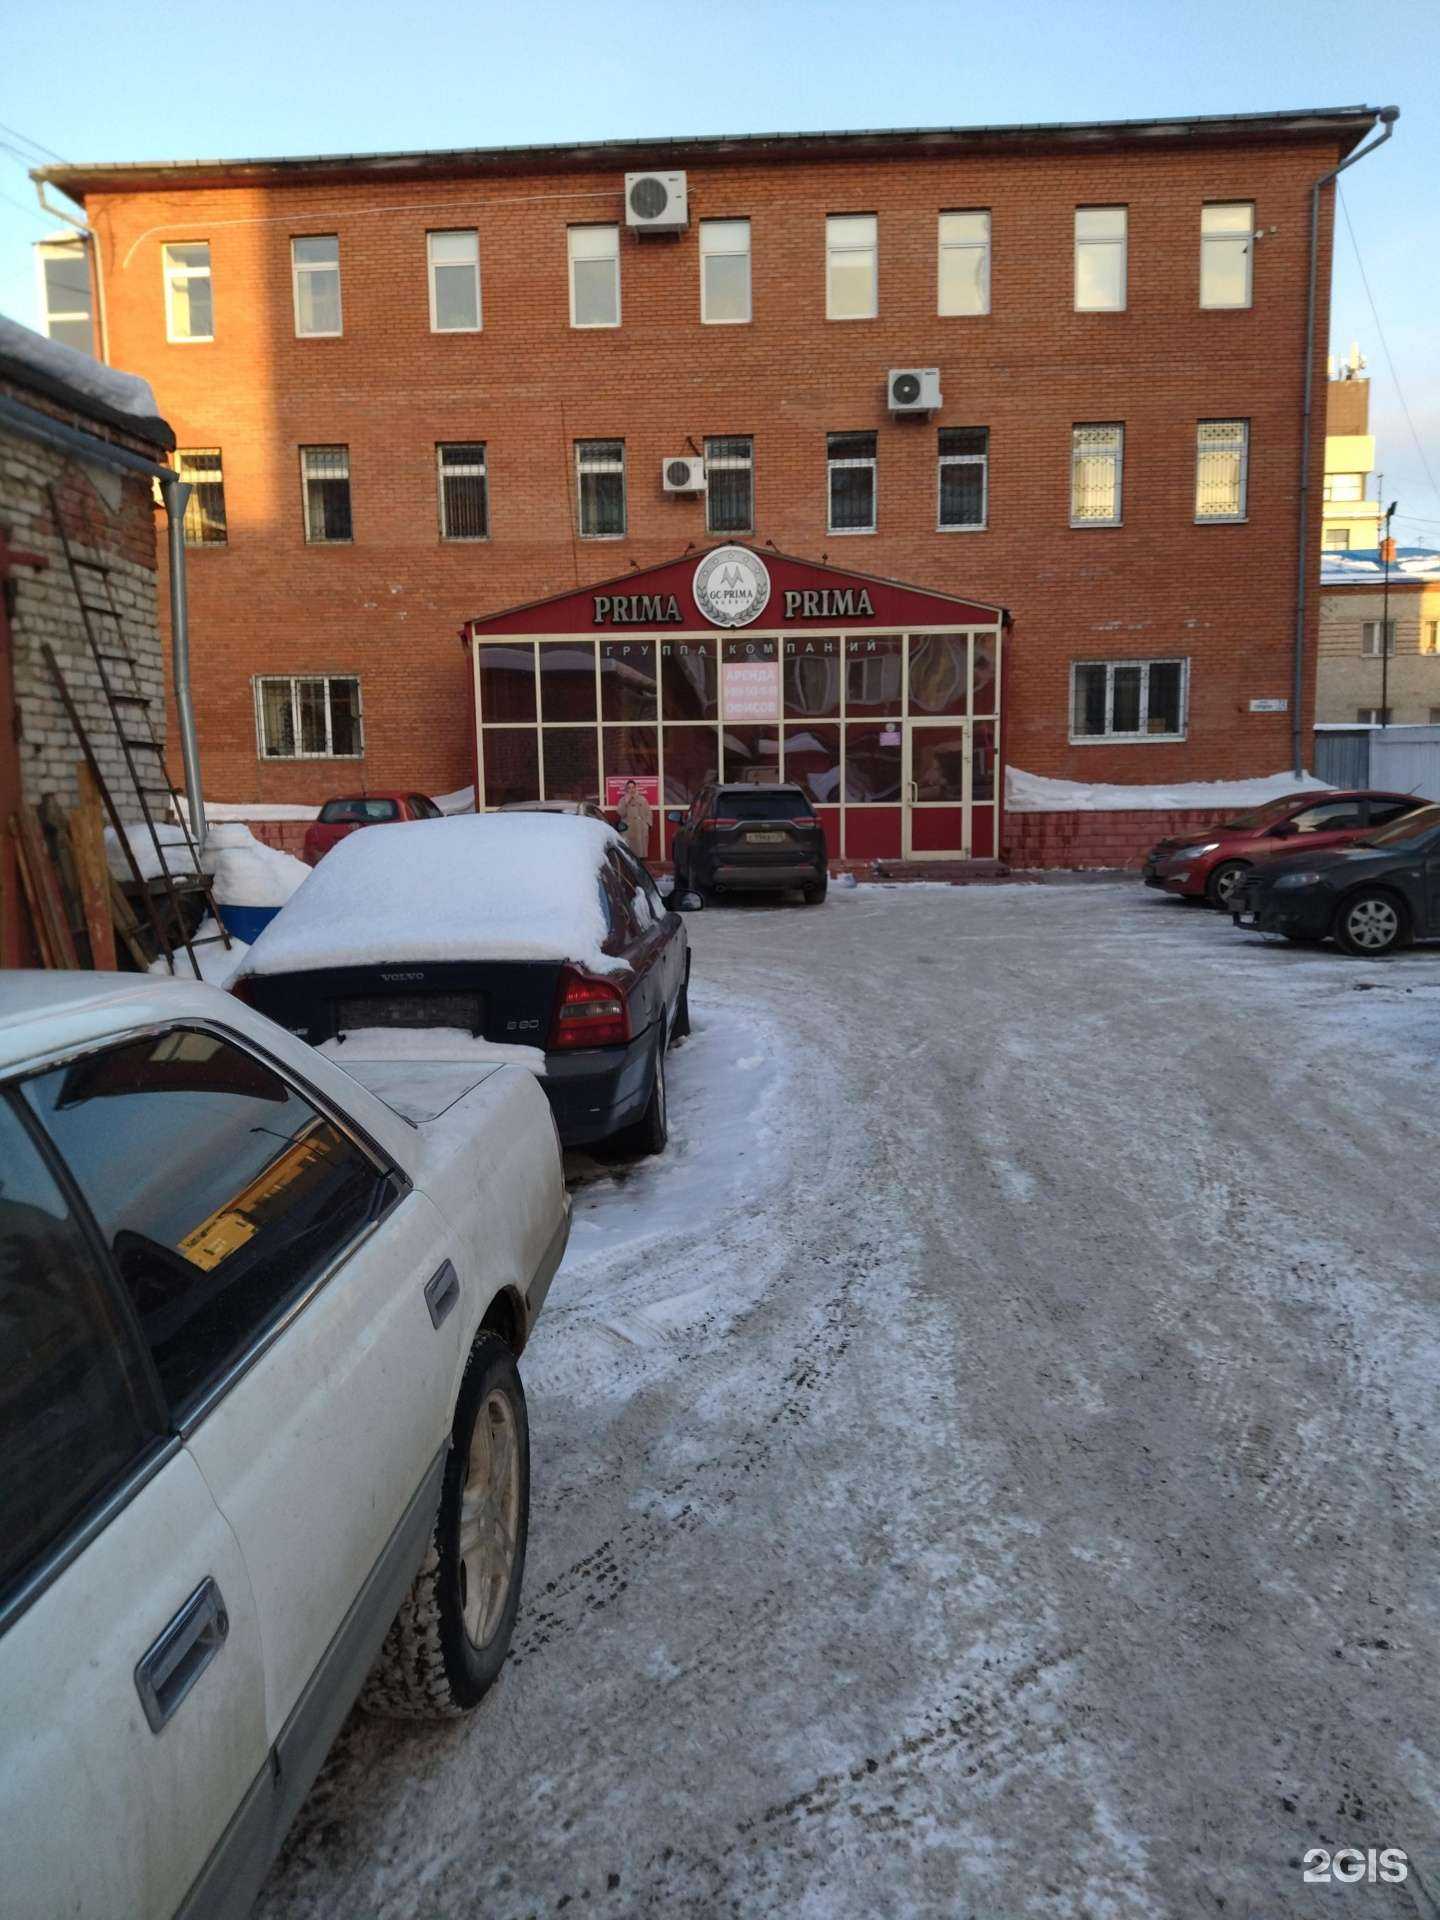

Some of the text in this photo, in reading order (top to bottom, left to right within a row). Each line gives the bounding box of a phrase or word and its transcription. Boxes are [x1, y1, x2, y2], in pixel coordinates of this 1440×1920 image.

[723, 589, 753, 599] PRIMA
[593, 595, 683, 623] PRIMA
[784, 588, 875, 618] PRIMA
[606, 639, 876, 656] ГРУППА КОМПАНИЙ
[380, 972, 424, 981] VOLVO
